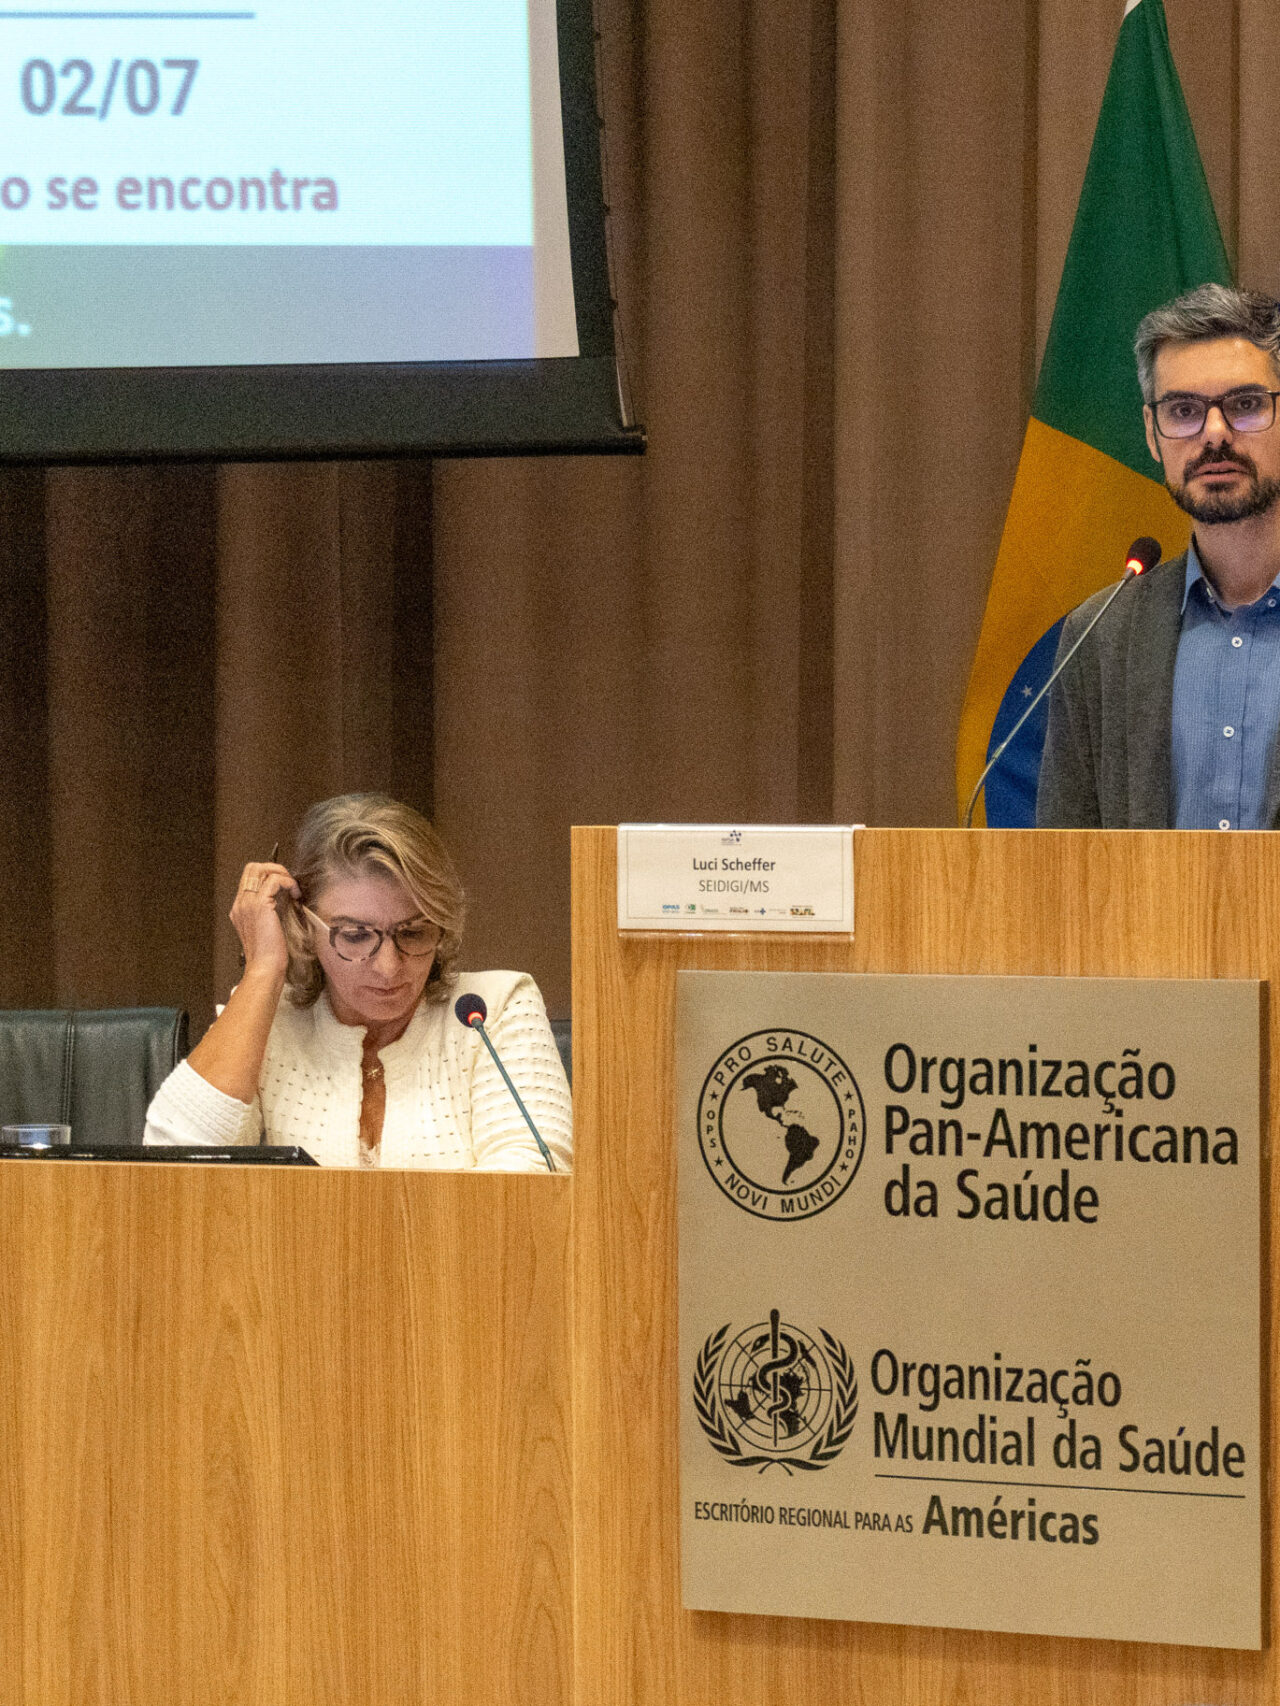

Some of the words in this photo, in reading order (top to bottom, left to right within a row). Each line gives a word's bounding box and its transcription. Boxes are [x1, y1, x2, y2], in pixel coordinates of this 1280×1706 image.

[20, 58, 200, 120] 02/07
[46, 176, 100, 211] se
[115, 168, 339, 212] encontra
[692, 857, 718, 871] Luci
[721, 857, 776, 872] Scheffer
[698, 879, 770, 895] SEIDIGI/MS
[713, 1046, 752, 1087] PRO
[766, 1036, 847, 1087] SALUTE
[883, 1042, 1177, 1119] Organização
[706, 1110, 717, 1149] OPS
[847, 1108, 858, 1160] PAHO
[884, 1104, 1239, 1166] Pan-Americana
[724, 1172, 769, 1211] NOVI
[780, 1174, 842, 1214] MUNDI
[883, 1163, 940, 1218] da
[956, 1168, 1100, 1224] Saúde
[870, 1348, 1123, 1420] Organização
[872, 1410, 1036, 1468] Mundial
[1052, 1418, 1103, 1471] da
[1117, 1424, 1247, 1479] Saúde
[694, 1497, 775, 1525] ESCRITÓRIO
[778, 1506, 850, 1530] REGIONAL
[854, 1511, 893, 1533] PARA
[894, 1514, 914, 1534] AS
[921, 1494, 1100, 1546] Américas
